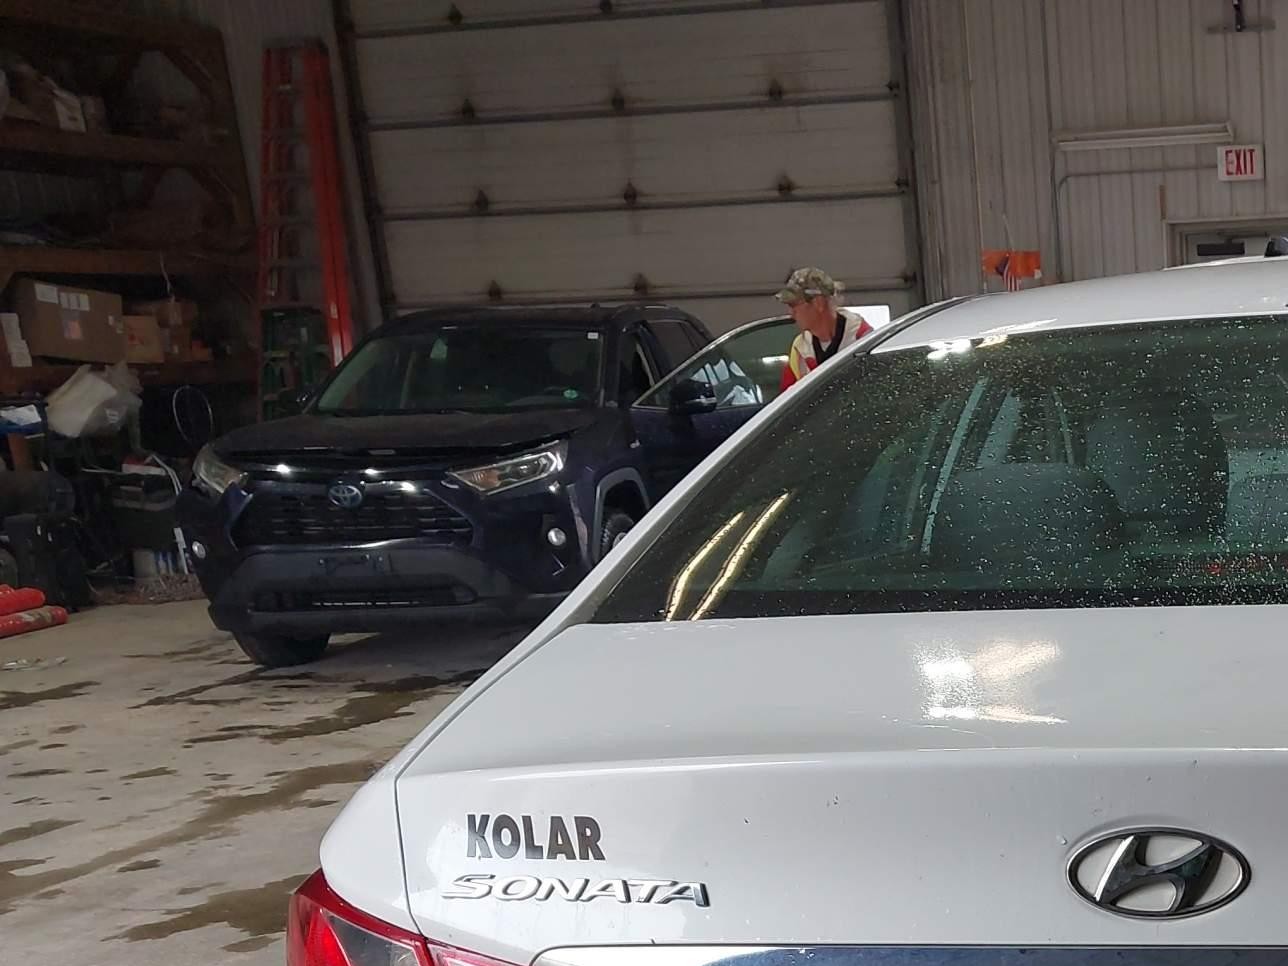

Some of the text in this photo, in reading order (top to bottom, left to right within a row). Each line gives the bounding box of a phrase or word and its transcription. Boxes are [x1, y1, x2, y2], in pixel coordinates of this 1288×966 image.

[1225, 149, 1255, 176] EXIT
[466, 814, 606, 861] KOLAR
[441, 874, 711, 907] SONATA
